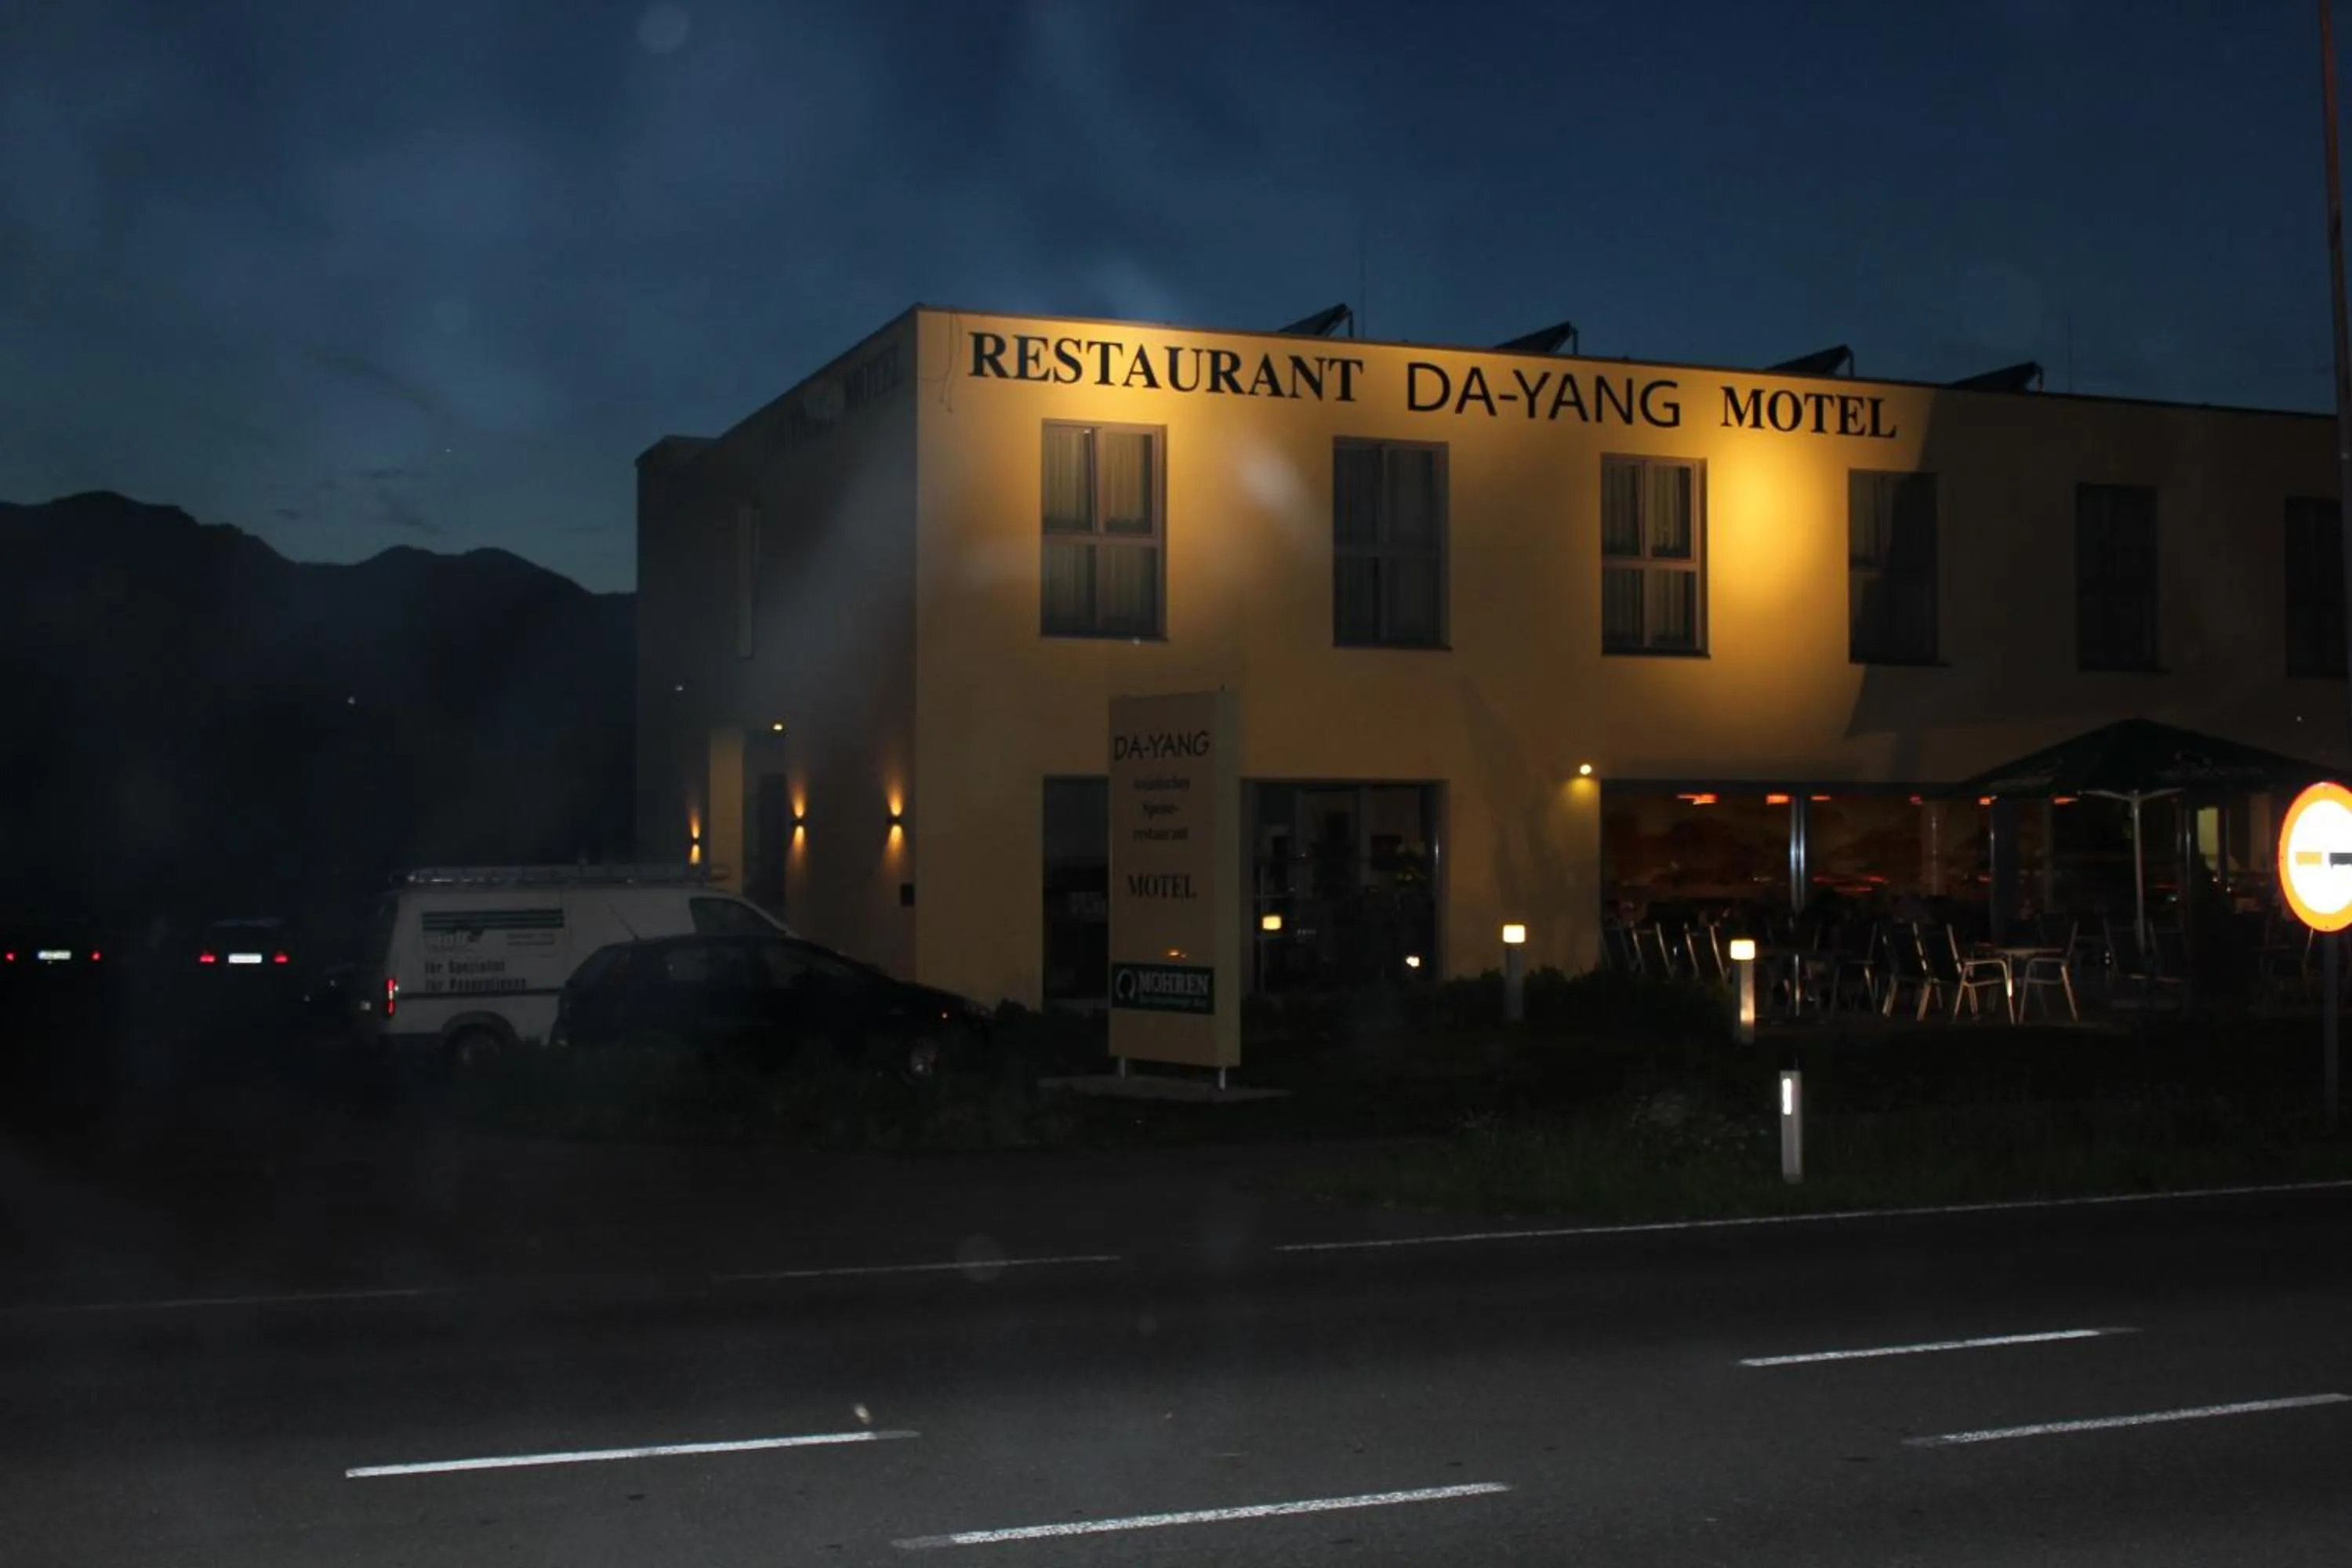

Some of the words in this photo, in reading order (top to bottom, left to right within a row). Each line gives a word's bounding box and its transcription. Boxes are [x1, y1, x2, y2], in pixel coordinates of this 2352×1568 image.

[968, 332, 1363, 402] RESTAURANT
[1406, 361, 1681, 428] DA-YANG
[1720, 386, 1896, 439] MOTEL
[1113, 730, 1210, 760] DA-YANG
[1127, 873, 1198, 900] MOTEL
[1138, 970, 1210, 995] MOHREN
